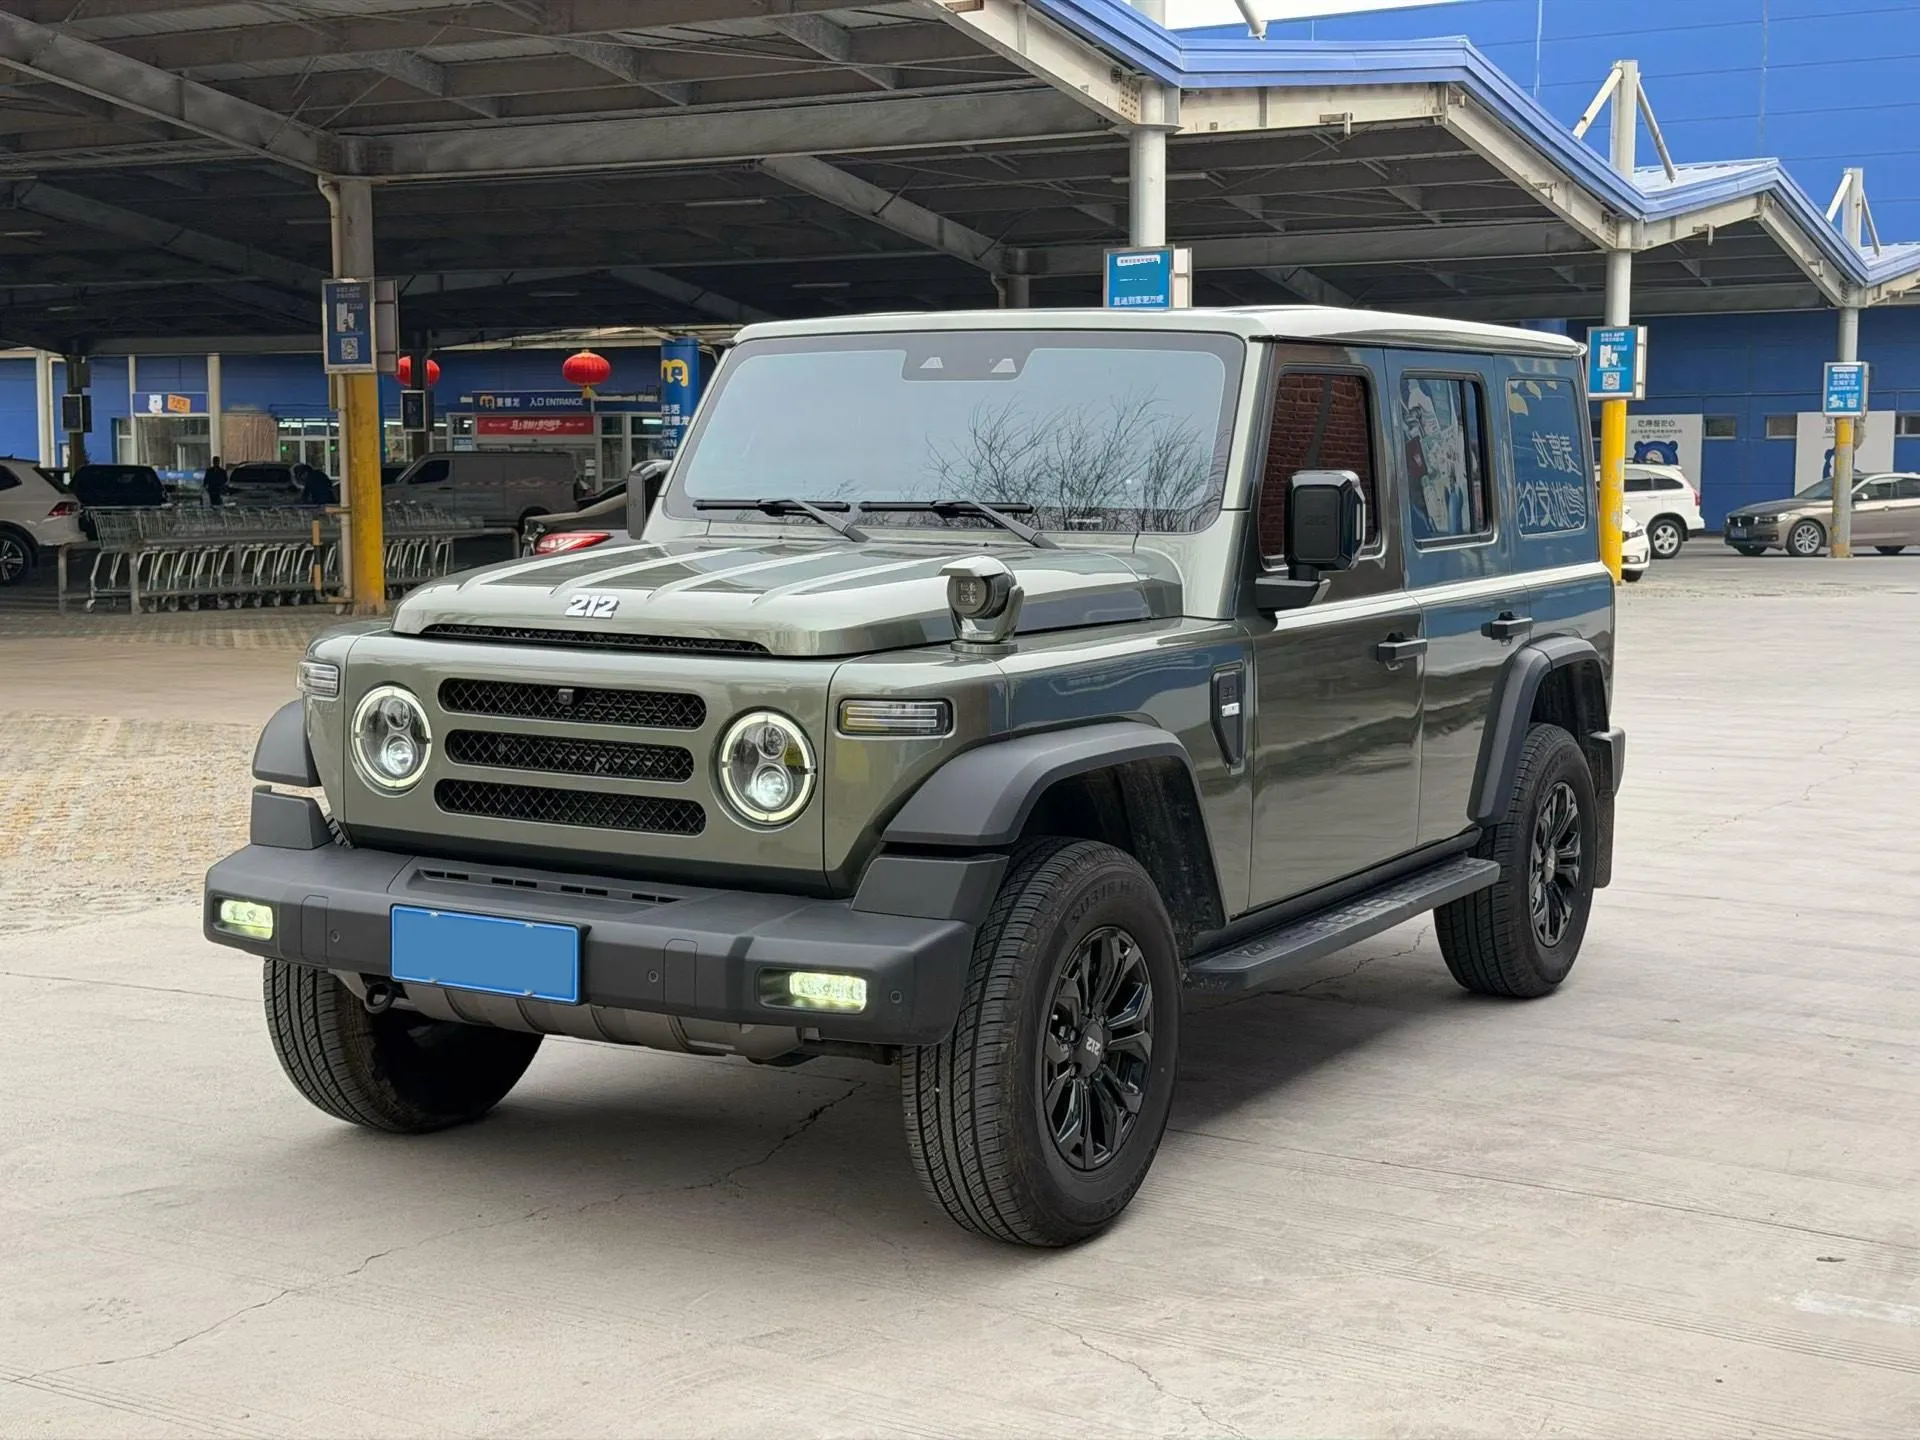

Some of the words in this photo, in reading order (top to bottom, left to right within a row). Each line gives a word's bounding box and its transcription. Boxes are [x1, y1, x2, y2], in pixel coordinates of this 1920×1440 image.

[530, 397, 544, 407] 入口
[546, 397, 584, 406] ENTRANCE
[564, 593, 620, 620] 212
[1085, 1035, 1101, 1057] 212
